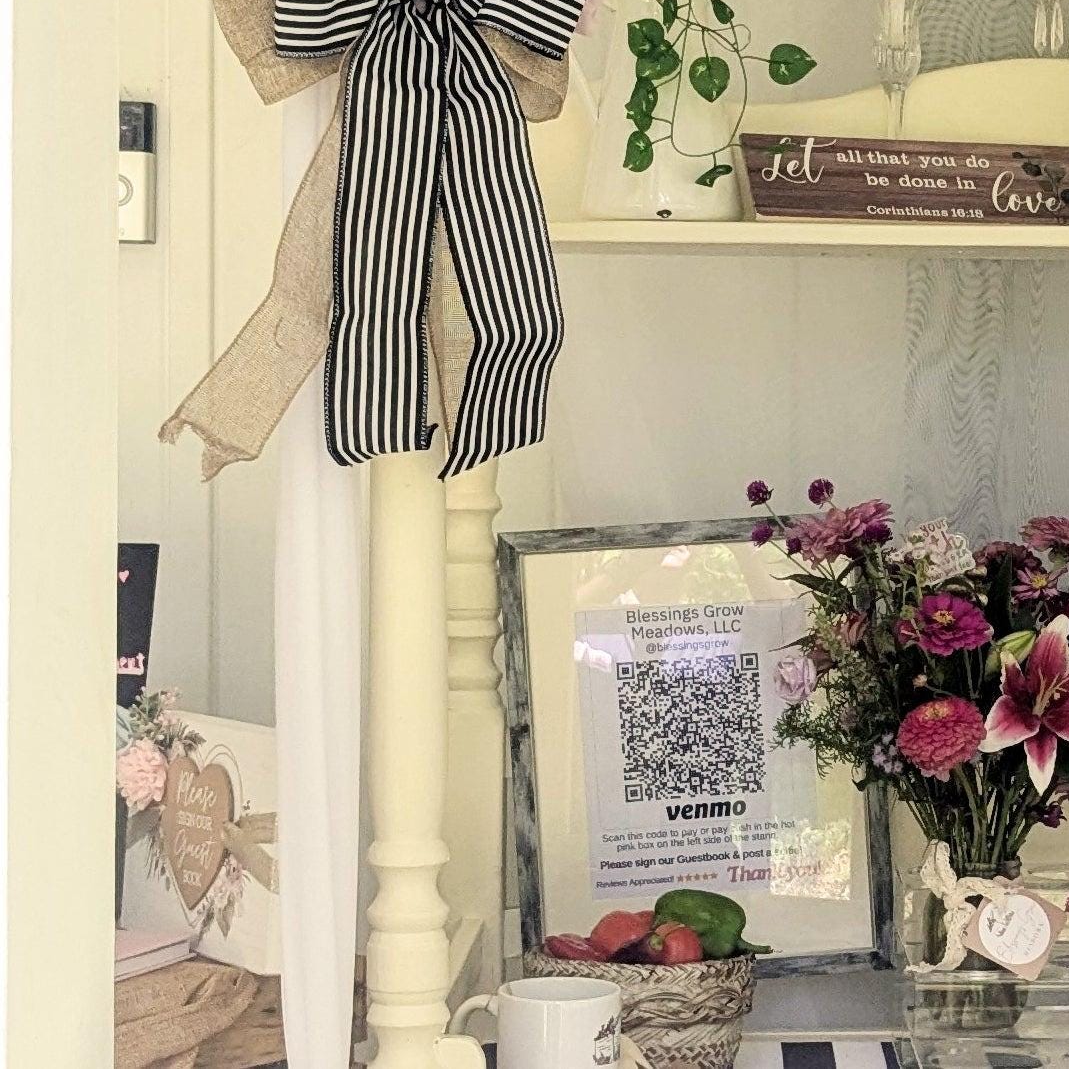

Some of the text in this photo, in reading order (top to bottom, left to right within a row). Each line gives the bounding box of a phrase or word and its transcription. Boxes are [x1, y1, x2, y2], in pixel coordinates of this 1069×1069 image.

[762, 137, 990, 183] Let all that you do
[864, 171, 1062, 213] be done in love
[867, 205, 985, 219] Corinthians 16:18
[626, 604, 744, 624] Blessings Grow
[631, 619, 742, 640] Meadows, LLC
[645, 638, 730, 654] @blessingsgrow
[665, 800, 747, 821] venmo
[602, 833, 626, 843] Scan
[627, 831, 643, 841] this
[645, 830, 668, 840] code
[670, 828, 679, 837] to
[681, 828, 698, 837] pay
[700, 827, 710, 835] or
[711, 826, 728, 836] pay
[754, 822, 762, 830] in
[764, 821, 779, 829] the
[616, 842, 636, 852] pink
[637, 841, 655, 850] box
[670, 838, 685, 847] the
[686, 837, 702, 845] left
[703, 836, 722, 845] side
[600, 861, 633, 870] Please
[634, 857, 656, 868] sign
[657, 856, 675, 865] our
[676, 851, 731, 864] Guestbook
[732, 850, 741, 860] &
[742, 848, 764, 861] post
[765, 848, 772, 858] a
